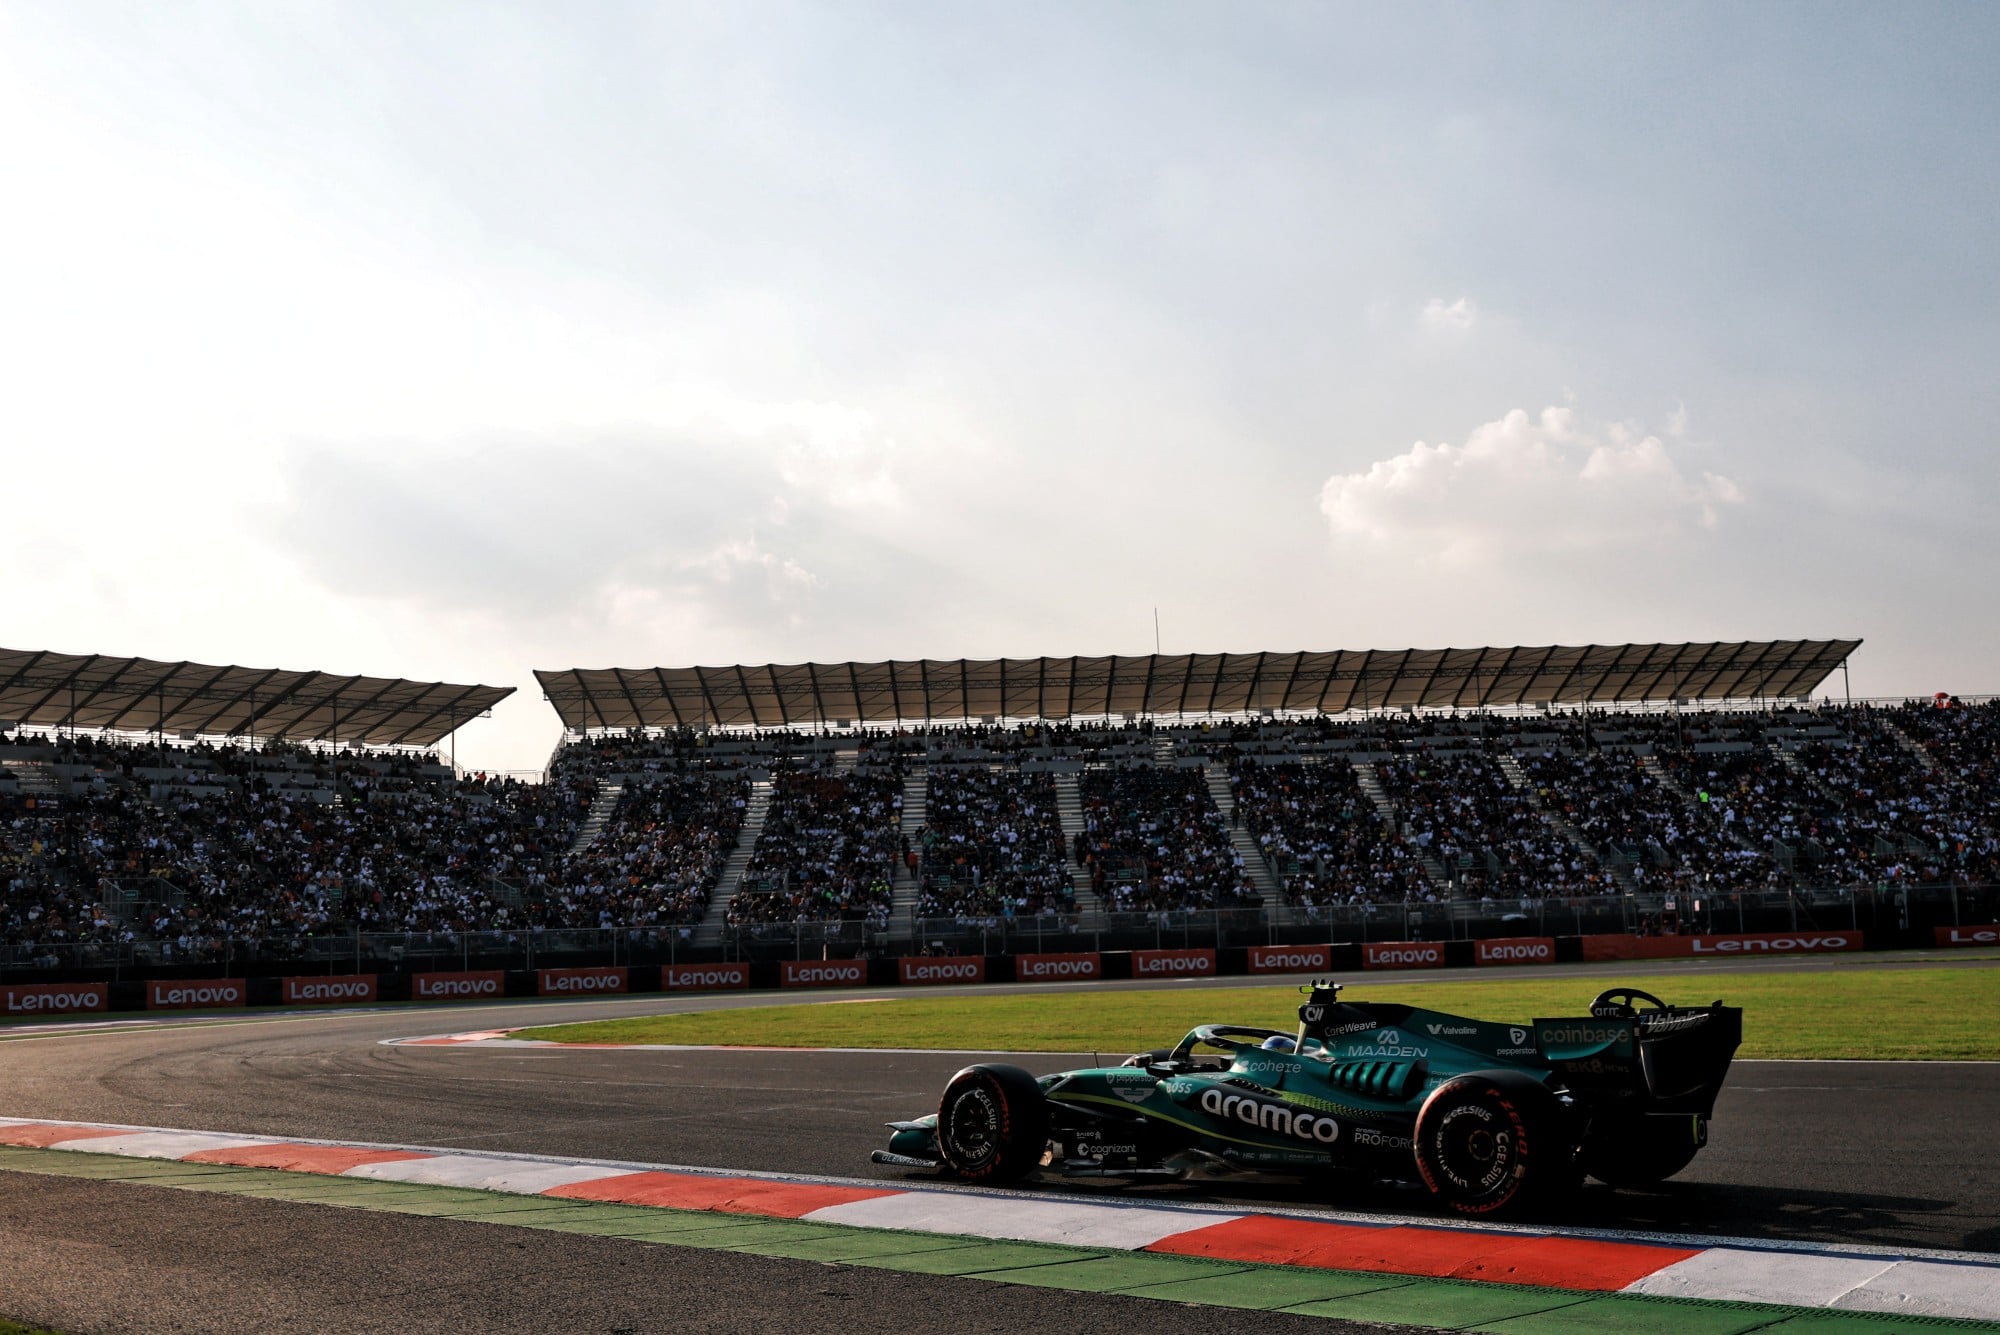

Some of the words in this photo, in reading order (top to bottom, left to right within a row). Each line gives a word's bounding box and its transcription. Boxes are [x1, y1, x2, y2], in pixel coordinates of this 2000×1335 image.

[1951, 930, 2000, 942] Le
[1481, 944, 1548, 959] Lenovo
[1692, 937, 1847, 952] Lenovo
[1255, 952, 1324, 967] Lenovo
[1369, 948, 1437, 963] Lenovo
[906, 964, 977, 979] Lenovo
[1023, 960, 1094, 975] Lenovo
[1139, 957, 1209, 971] Lenovo
[669, 970, 742, 986] Lenovo
[788, 966, 860, 981] Lenovo
[291, 982, 369, 998] Lenovo
[420, 978, 497, 994] Lenovo
[546, 975, 620, 990] Lenovo
[8, 992, 99, 1010] Lenovo
[155, 987, 238, 1004] Lenovo
[1324, 1021, 1377, 1037] CoreWeave
[1442, 1026, 1477, 1035] Valvoline
[1542, 1025, 1629, 1043] coinbase
[1347, 1045, 1429, 1058] MAADEN
[1497, 1047, 1538, 1056] pepperston
[1249, 1060, 1302, 1074] cohere
[1166, 1082, 1193, 1094] BOSS
[1201, 1089, 1339, 1143] aramco
[1354, 1133, 1415, 1150] PROFORC
[1090, 1144, 1137, 1156] cognizant
